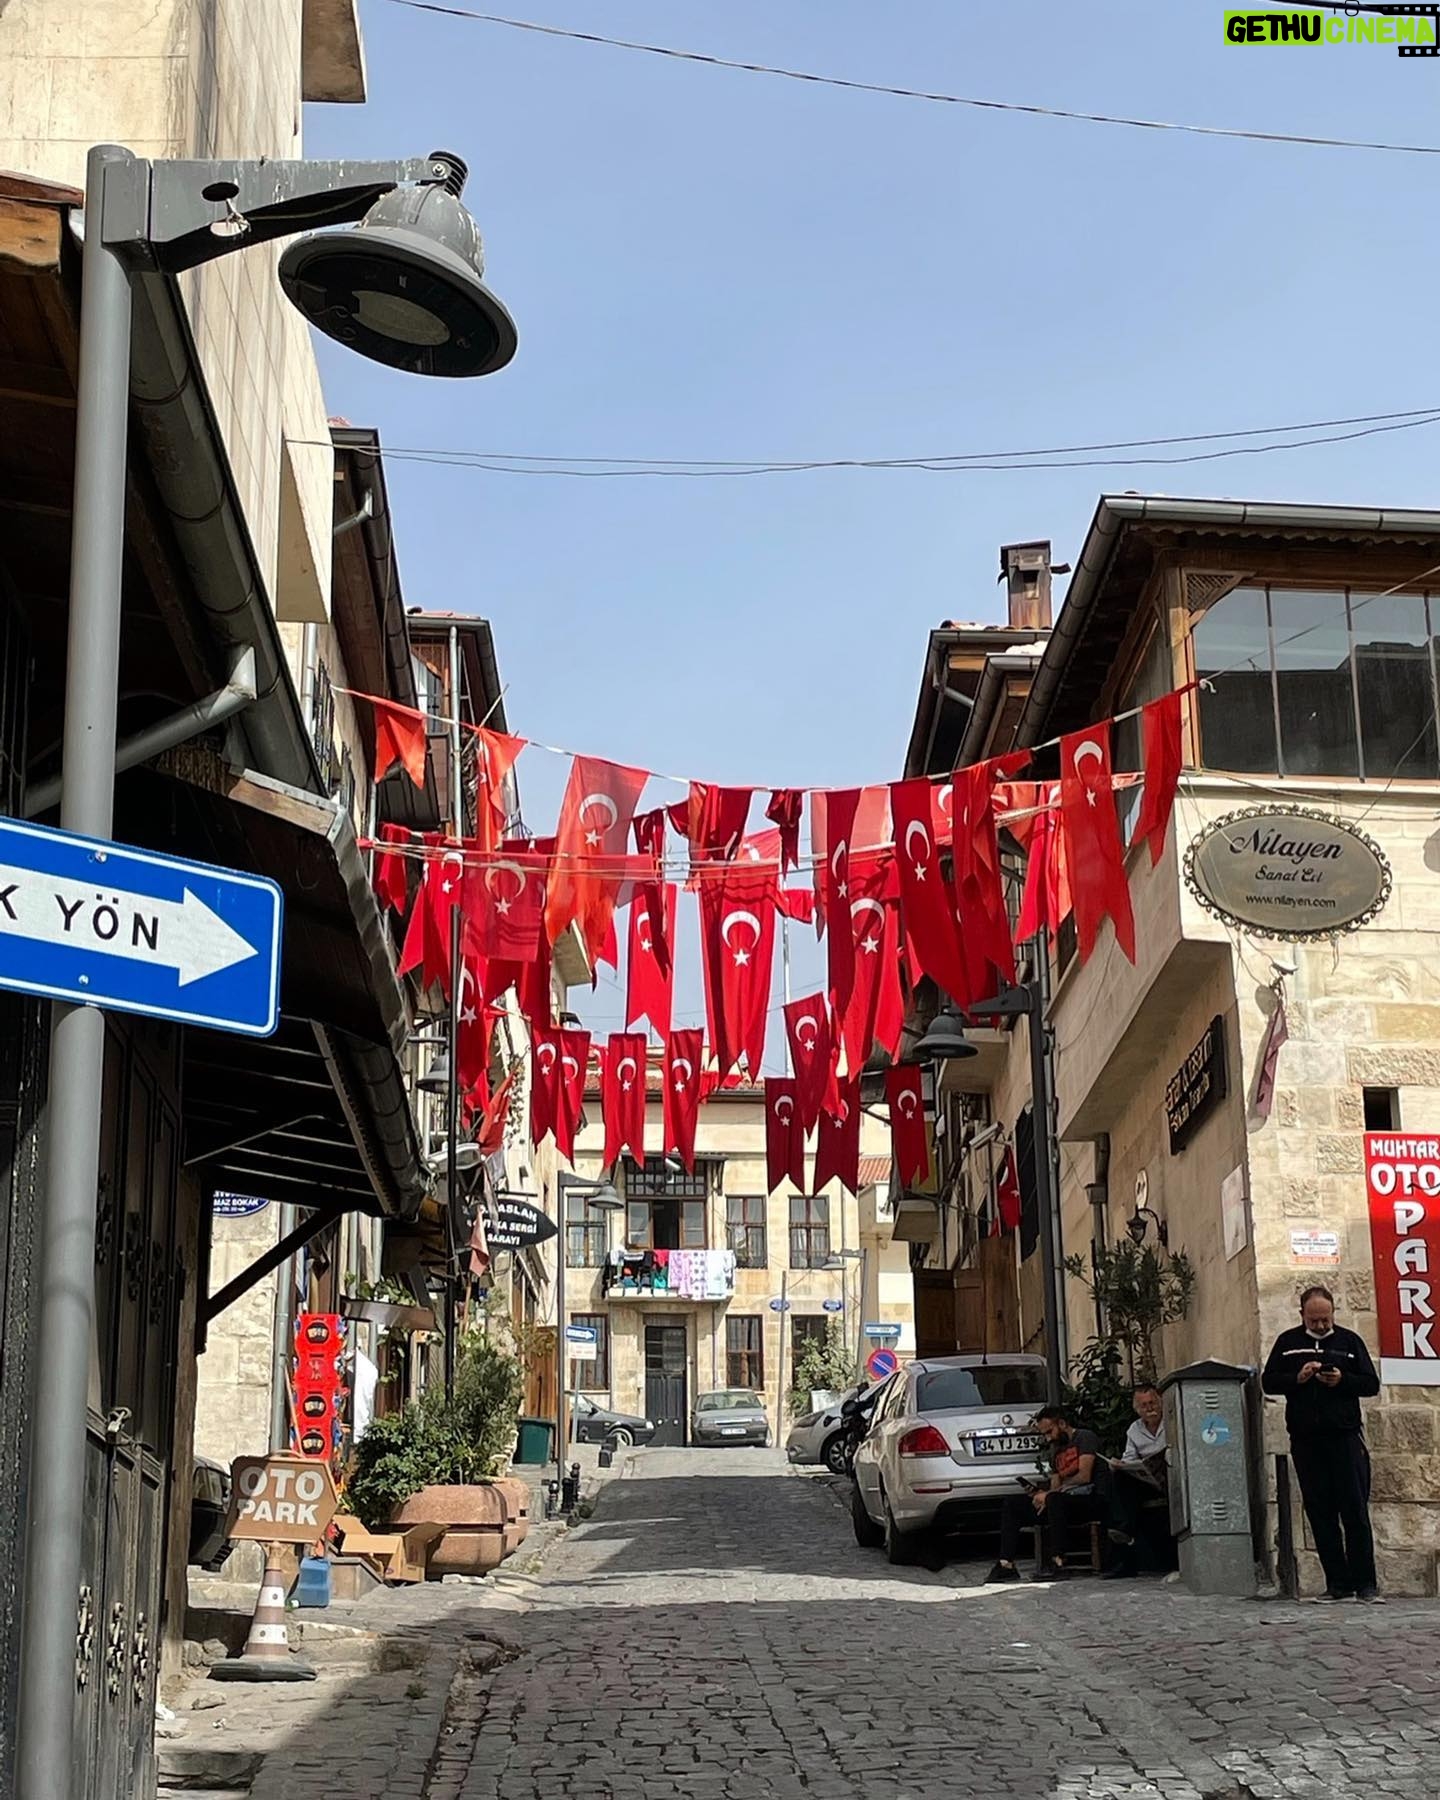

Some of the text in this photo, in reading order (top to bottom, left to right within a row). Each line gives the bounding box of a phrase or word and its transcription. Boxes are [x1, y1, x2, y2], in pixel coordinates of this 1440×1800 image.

[1230, 828, 1343, 864] Nilayen
[54, 894, 159, 951] YÖN
[1370, 1138, 1440, 1160] MUHTAR
[1370, 1162, 1440, 1197] OTO
[487, 1232, 520, 1245] SARAYI
[1393, 1200, 1437, 1358] PARK
[981, 1439, 995, 1451] 34
[999, 1438, 1013, 1450] YJ
[239, 1466, 325, 1501] OTO
[237, 1498, 319, 1526] PARK
